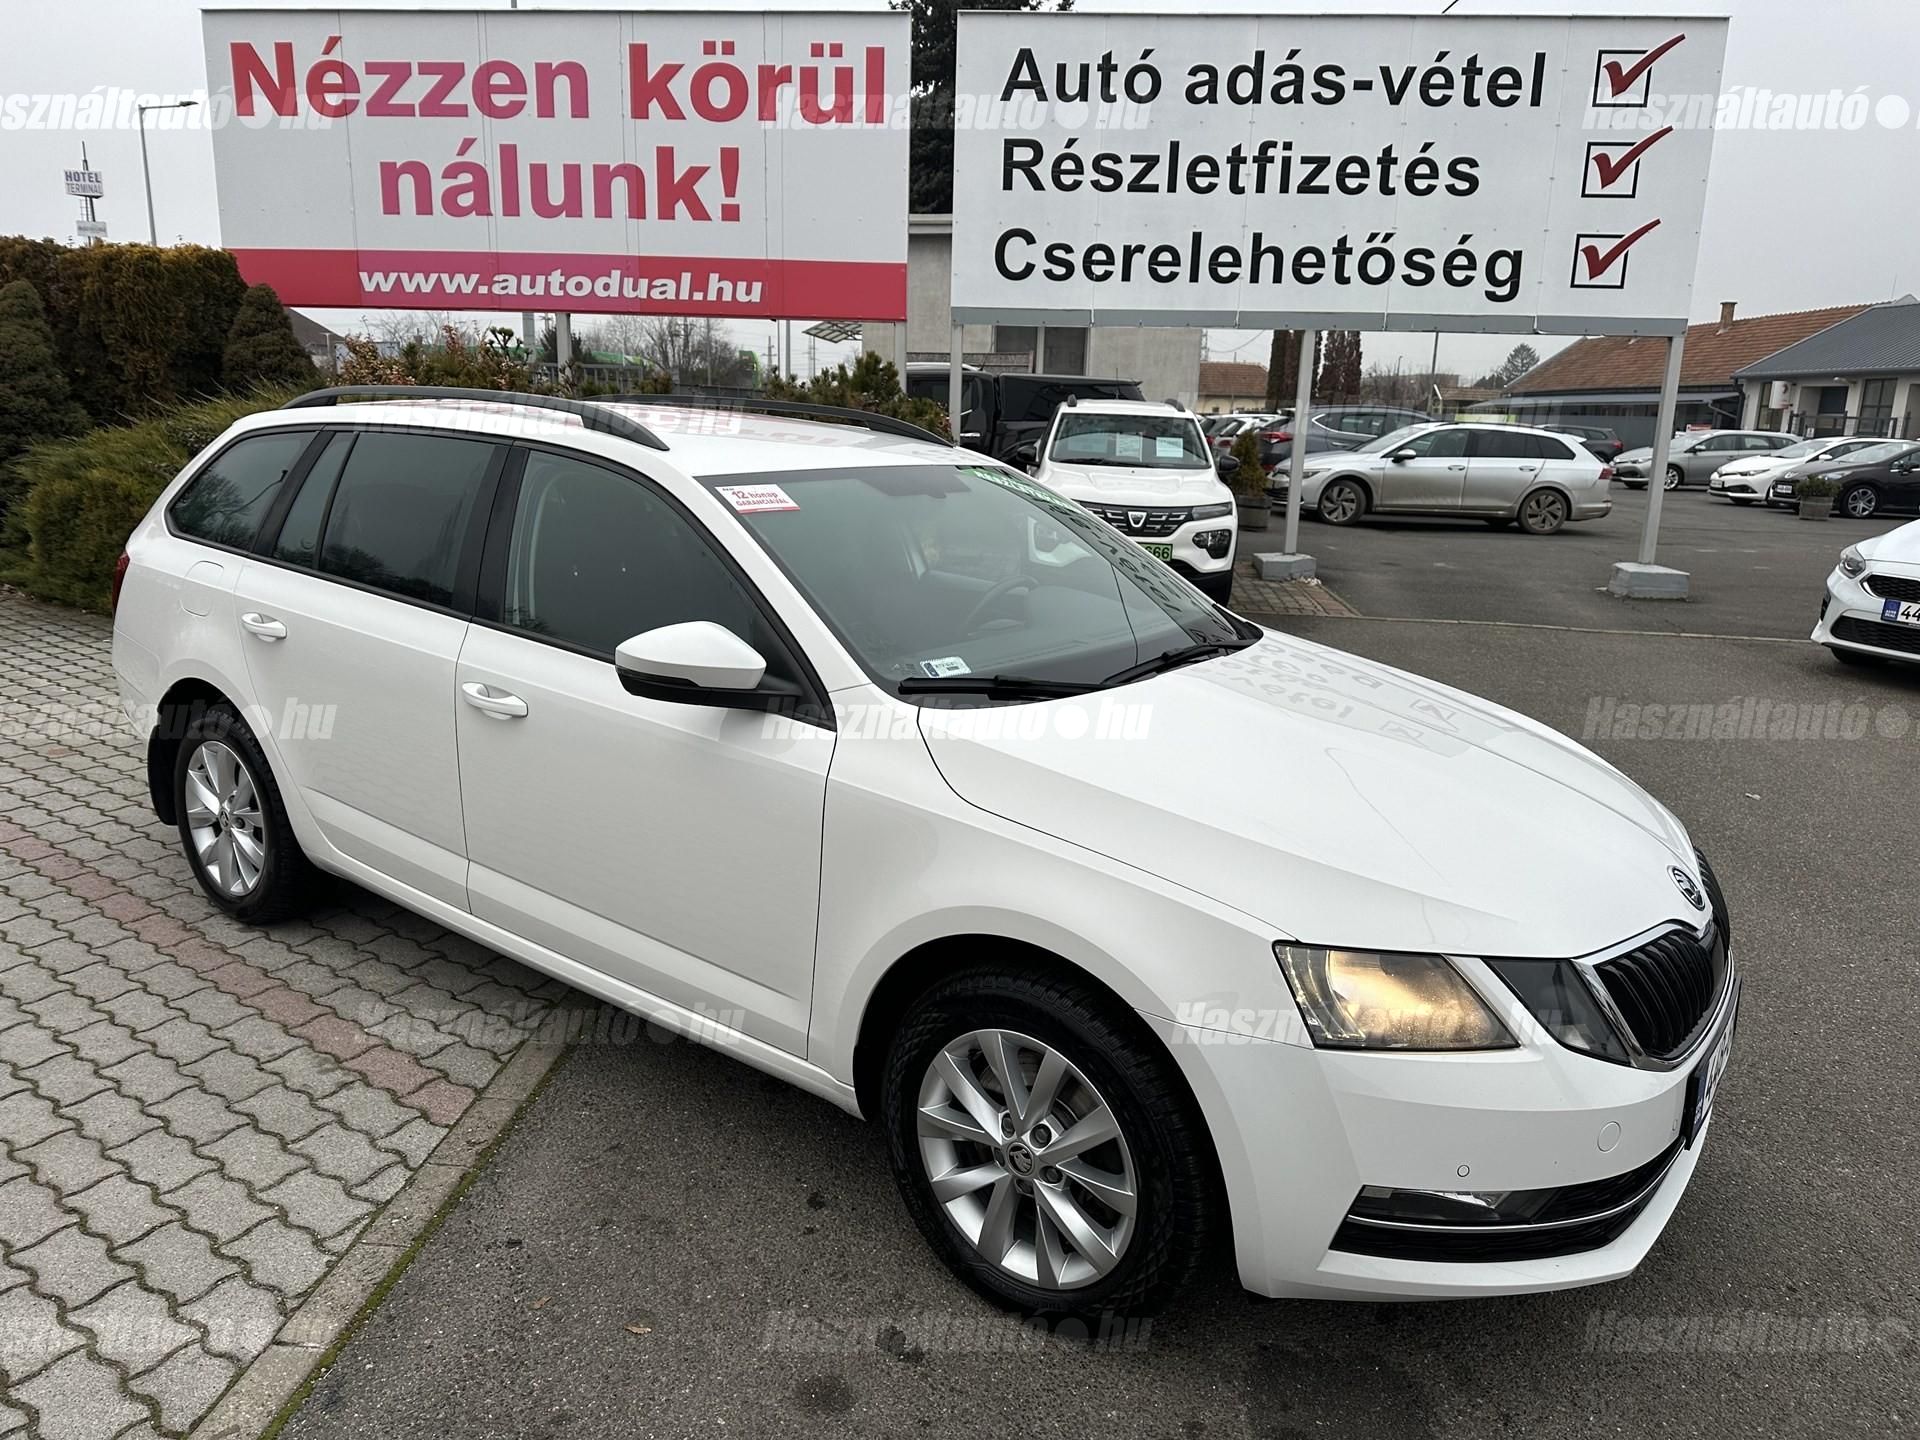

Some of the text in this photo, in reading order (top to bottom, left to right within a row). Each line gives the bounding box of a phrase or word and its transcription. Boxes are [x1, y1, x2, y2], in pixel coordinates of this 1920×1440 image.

[231, 36, 885, 125] Nézzen körül
[1000, 48, 1546, 108] Autó adás-vétel
[65, 171, 101, 183] HOTEL
[66, 183, 102, 194] TERMINAL
[380, 138, 740, 222] nálunk!
[1002, 137, 1480, 197] Részletfizetés
[359, 269, 762, 303] www.autodual.hu
[994, 228, 1523, 303] Cserelehetőség
[732, 491, 749, 499] 12
